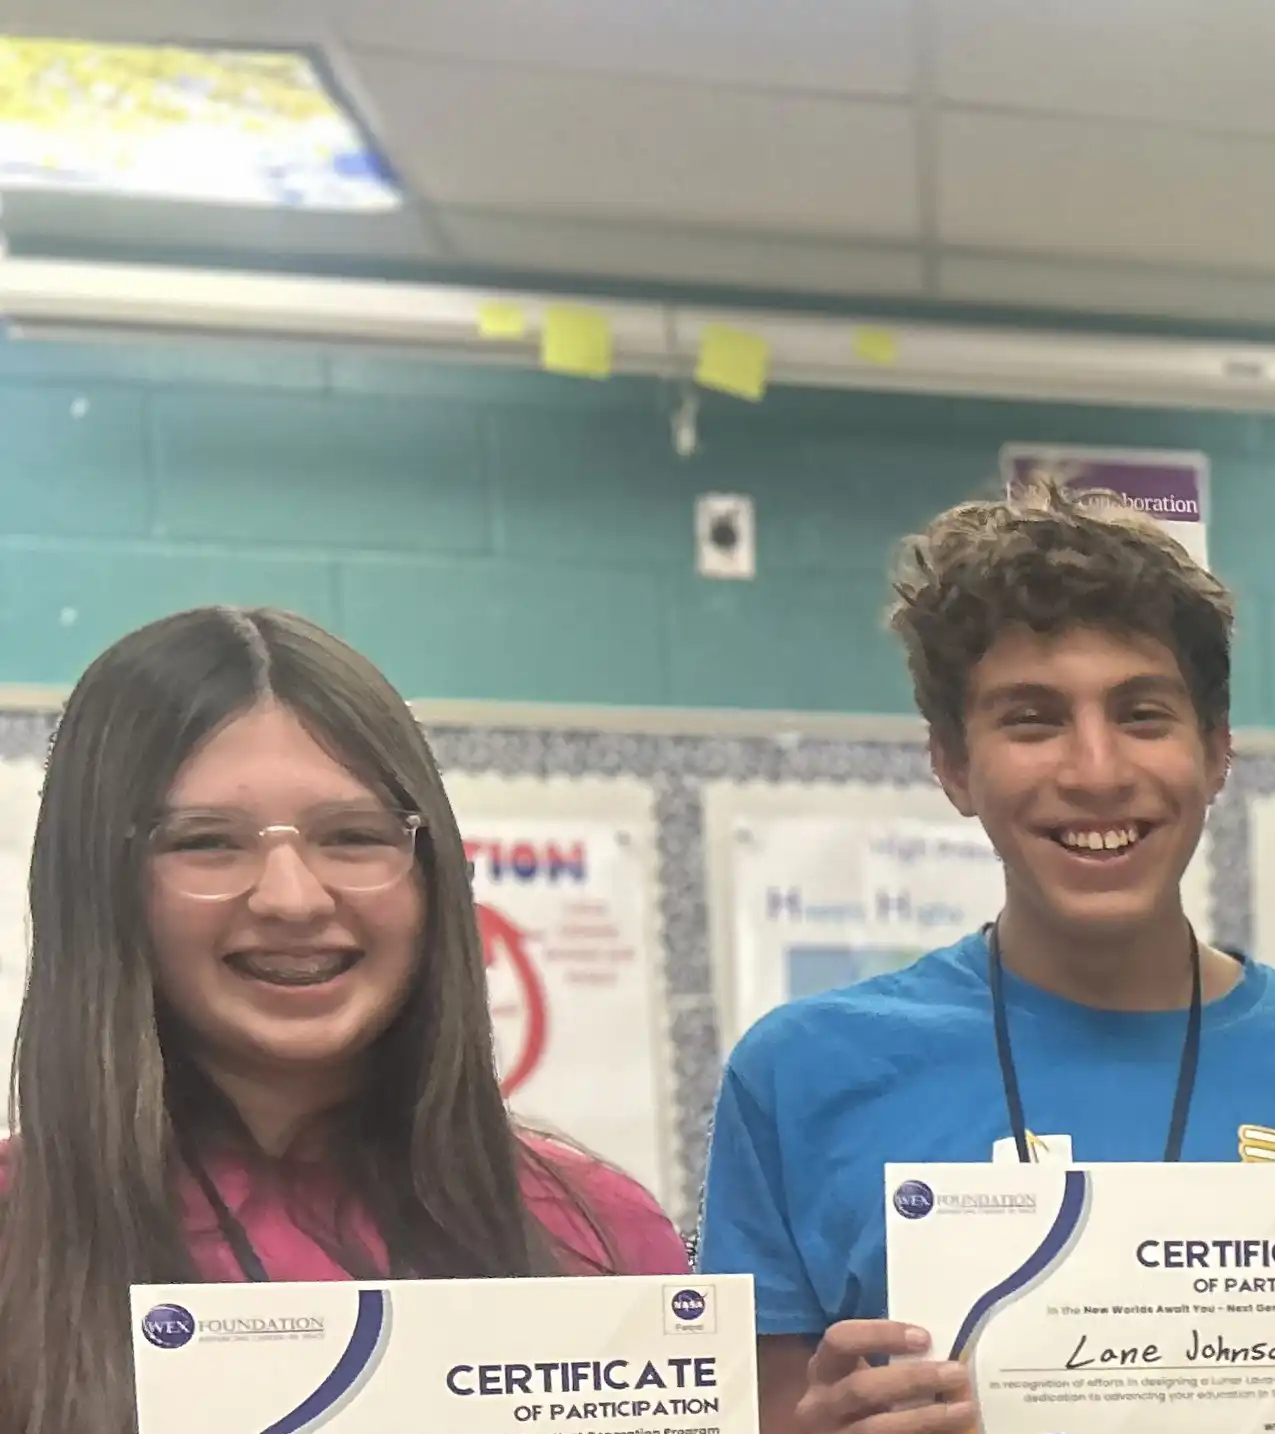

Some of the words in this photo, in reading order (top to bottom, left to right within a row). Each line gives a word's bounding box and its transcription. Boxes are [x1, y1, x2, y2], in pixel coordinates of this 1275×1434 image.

[1193, 1278, 1218, 1292] OF
[1084, 1306, 1109, 1314] New
[1112, 1305, 1153, 1314] Worlds
[1156, 1305, 1190, 1314] Await
[1193, 1305, 1215, 1314] You
[1227, 1304, 1253, 1313] Next
[199, 1317, 325, 1332] FOUNDATION
[1065, 1335, 1161, 1370] Lane
[446, 1357, 717, 1396] CERTIFICATE
[514, 1405, 544, 1422] OF
[550, 1397, 719, 1421] PARTICIPATION
